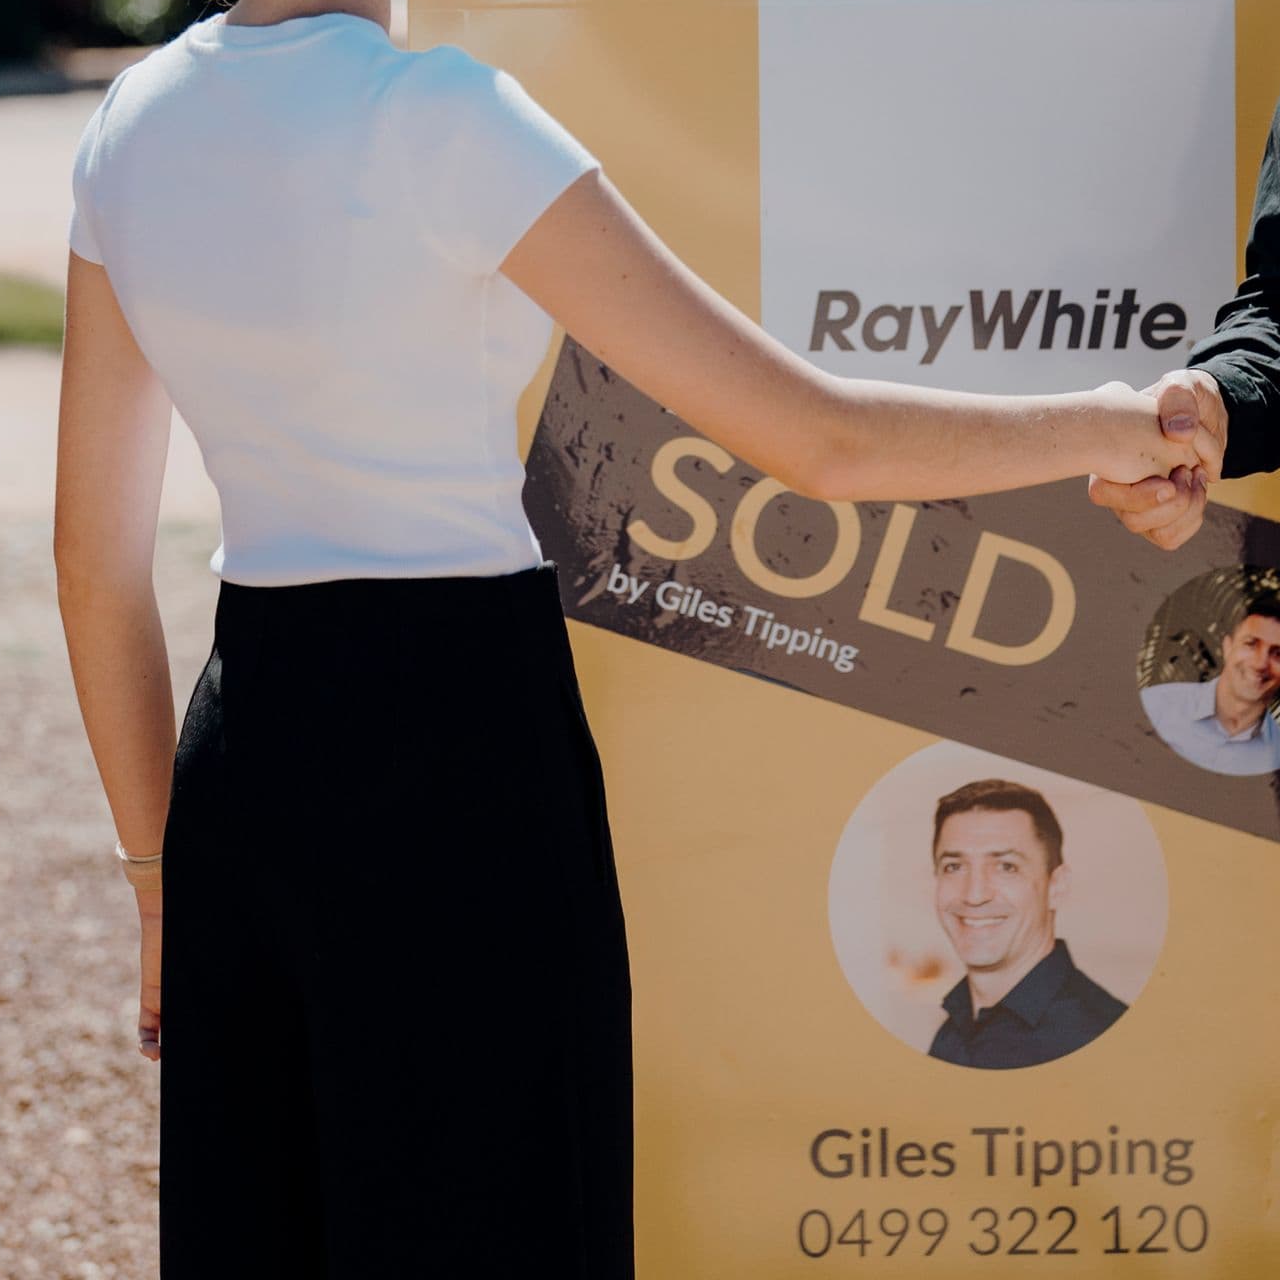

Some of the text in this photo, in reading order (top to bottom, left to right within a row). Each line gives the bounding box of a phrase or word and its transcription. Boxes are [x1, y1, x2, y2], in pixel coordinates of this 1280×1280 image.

[626, 436, 1077, 667] SOLD
[606, 563, 860, 673] by Giles Tipping
[808, 1124, 1195, 1187] Giles Tipping
[797, 1204, 1210, 1259] 0499 322 120
